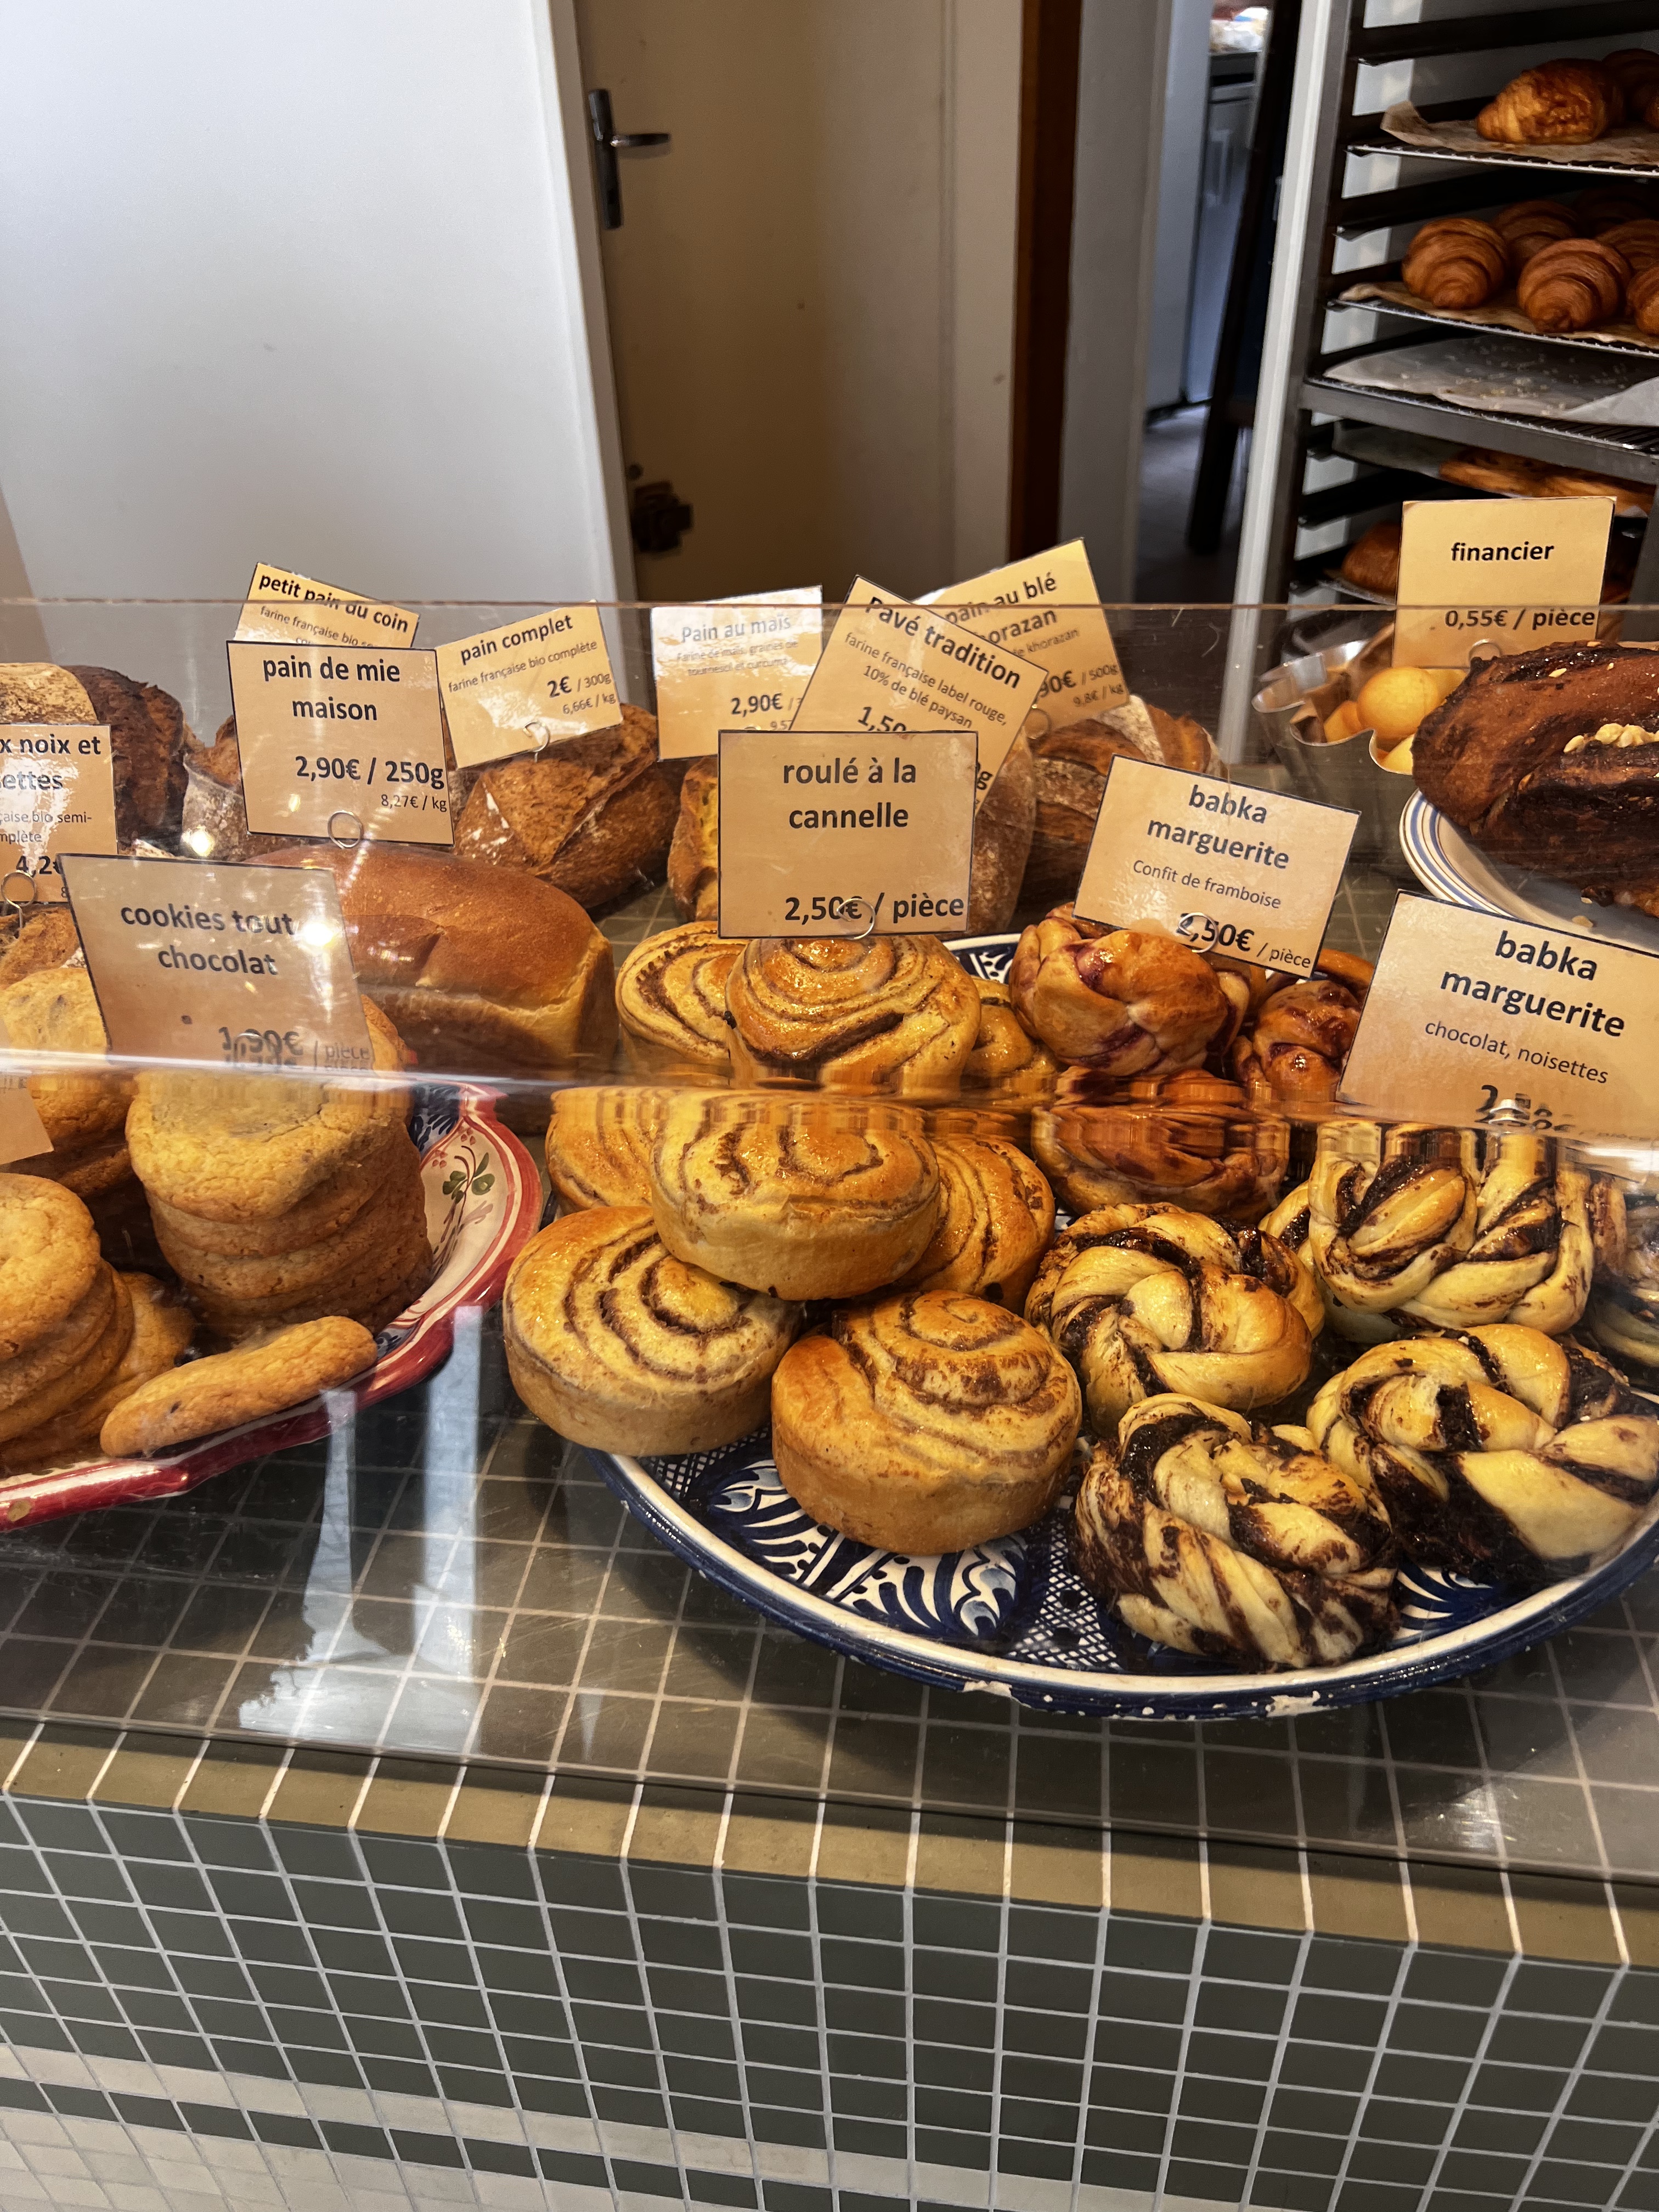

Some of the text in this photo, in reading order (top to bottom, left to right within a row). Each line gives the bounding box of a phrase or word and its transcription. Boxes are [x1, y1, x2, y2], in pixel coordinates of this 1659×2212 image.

[1451, 541, 1554, 562] financier
[258, 574, 409, 633] petit pain du coin
[945, 572, 1057, 624] pain au blé
[261, 606, 290, 624] farine
[293, 617, 340, 640] française
[341, 632, 358, 646] bio
[681, 614, 791, 643] Pain au maïs
[1444, 608, 1595, 630] 0,55€ / pièce
[461, 615, 573, 665] pain complet
[865, 596, 1020, 689] Pavé tradition
[263, 655, 400, 682] pain de mie
[448, 641, 597, 693] farine française bio complète
[844, 633, 1007, 726] farine française label rouge,
[546, 673, 612, 698] 2€ / 300g
[863, 665, 973, 728] 10% de blé paysan
[292, 697, 377, 720] maison
[562, 693, 617, 715] 6,66€ / kg
[731, 693, 783, 718] 2,90€
[20, 733, 71, 755] noix
[78, 736, 101, 755] et
[295, 756, 444, 789] 2,90€ / 250g
[783, 757, 916, 783] roulé à la
[32, 810, 53, 822] bio
[58, 811, 92, 823] semi-
[381, 794, 447, 812] 8,27€ / kg
[789, 802, 909, 828] cannelle
[1188, 785, 1267, 824] babka
[1147, 820, 1289, 869] marguerite
[1133, 860, 1281, 909] Confit de framboise
[121, 904, 294, 935] cookies tout
[785, 892, 964, 925] 2,50€ / pièce
[1176, 913, 1311, 968] 2,50€ / pièce
[1495, 930, 1598, 981] babka
[158, 945, 279, 975] chocolat
[1441, 971, 1625, 1037] marguerite
[1425, 1020, 1609, 1084] chocolat, noisettes
